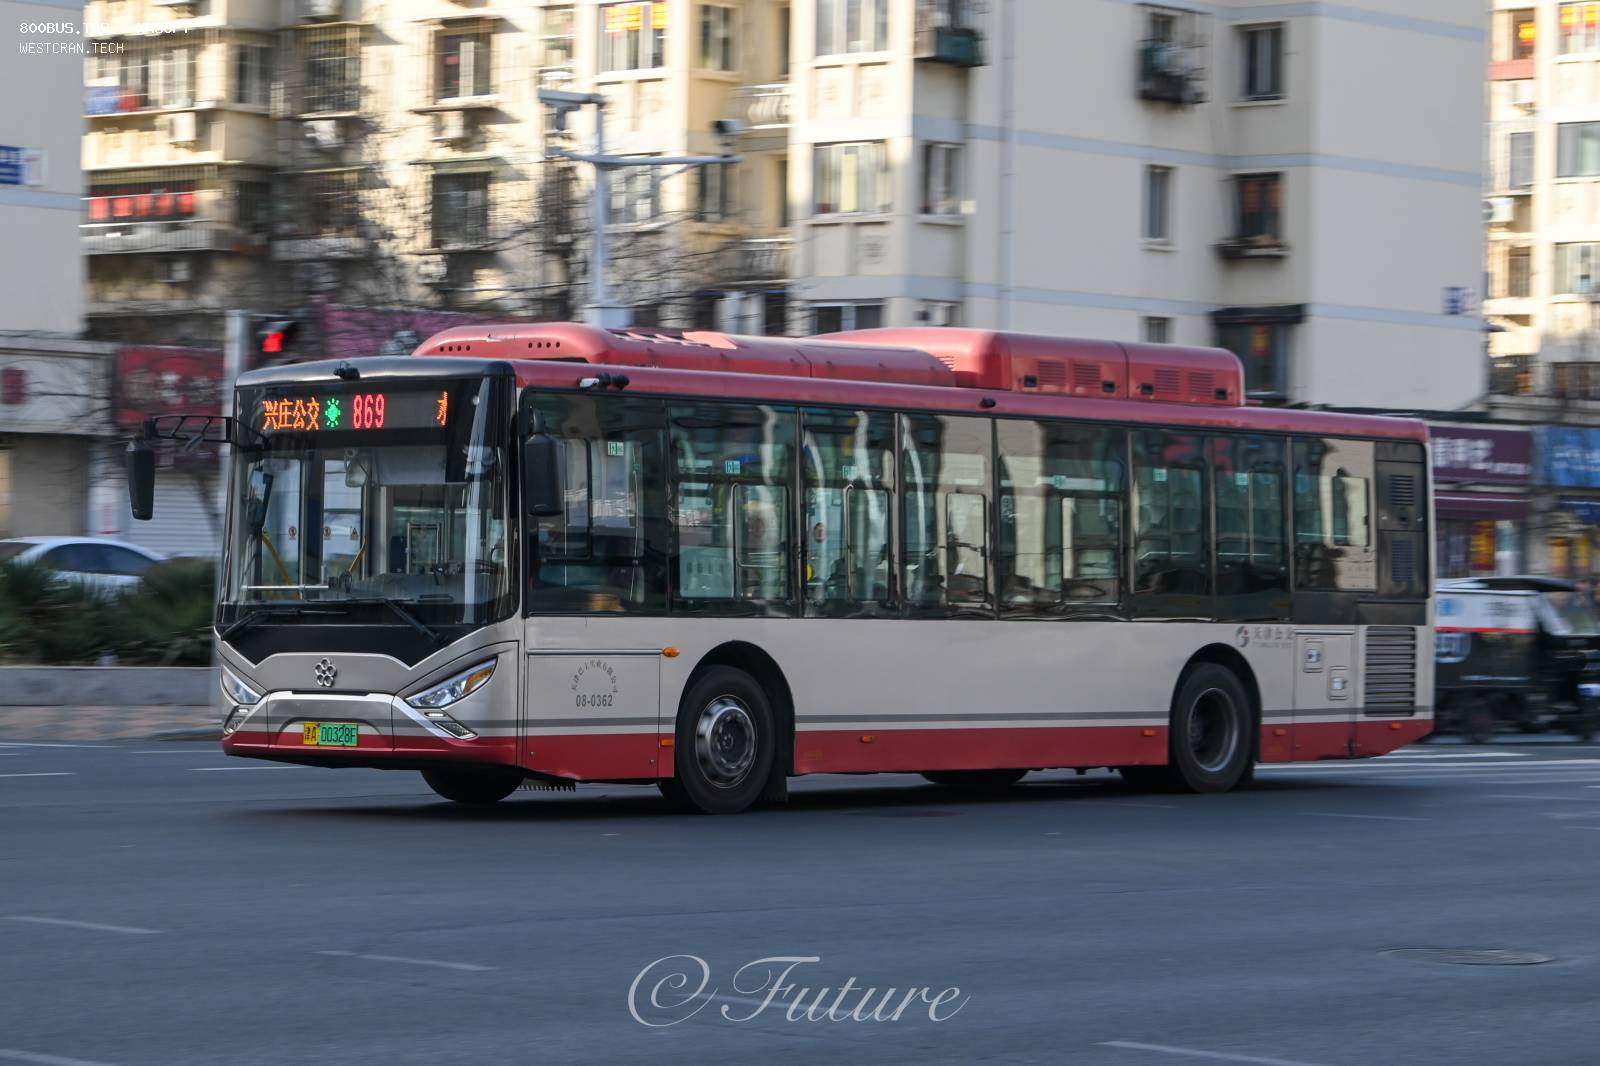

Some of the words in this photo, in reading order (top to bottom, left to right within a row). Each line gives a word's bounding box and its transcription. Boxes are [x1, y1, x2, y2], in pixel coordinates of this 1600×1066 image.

[262, 396, 321, 431] 兴庄公交
[353, 393, 385, 429] 869
[575, 694, 613, 708] 08-0362
